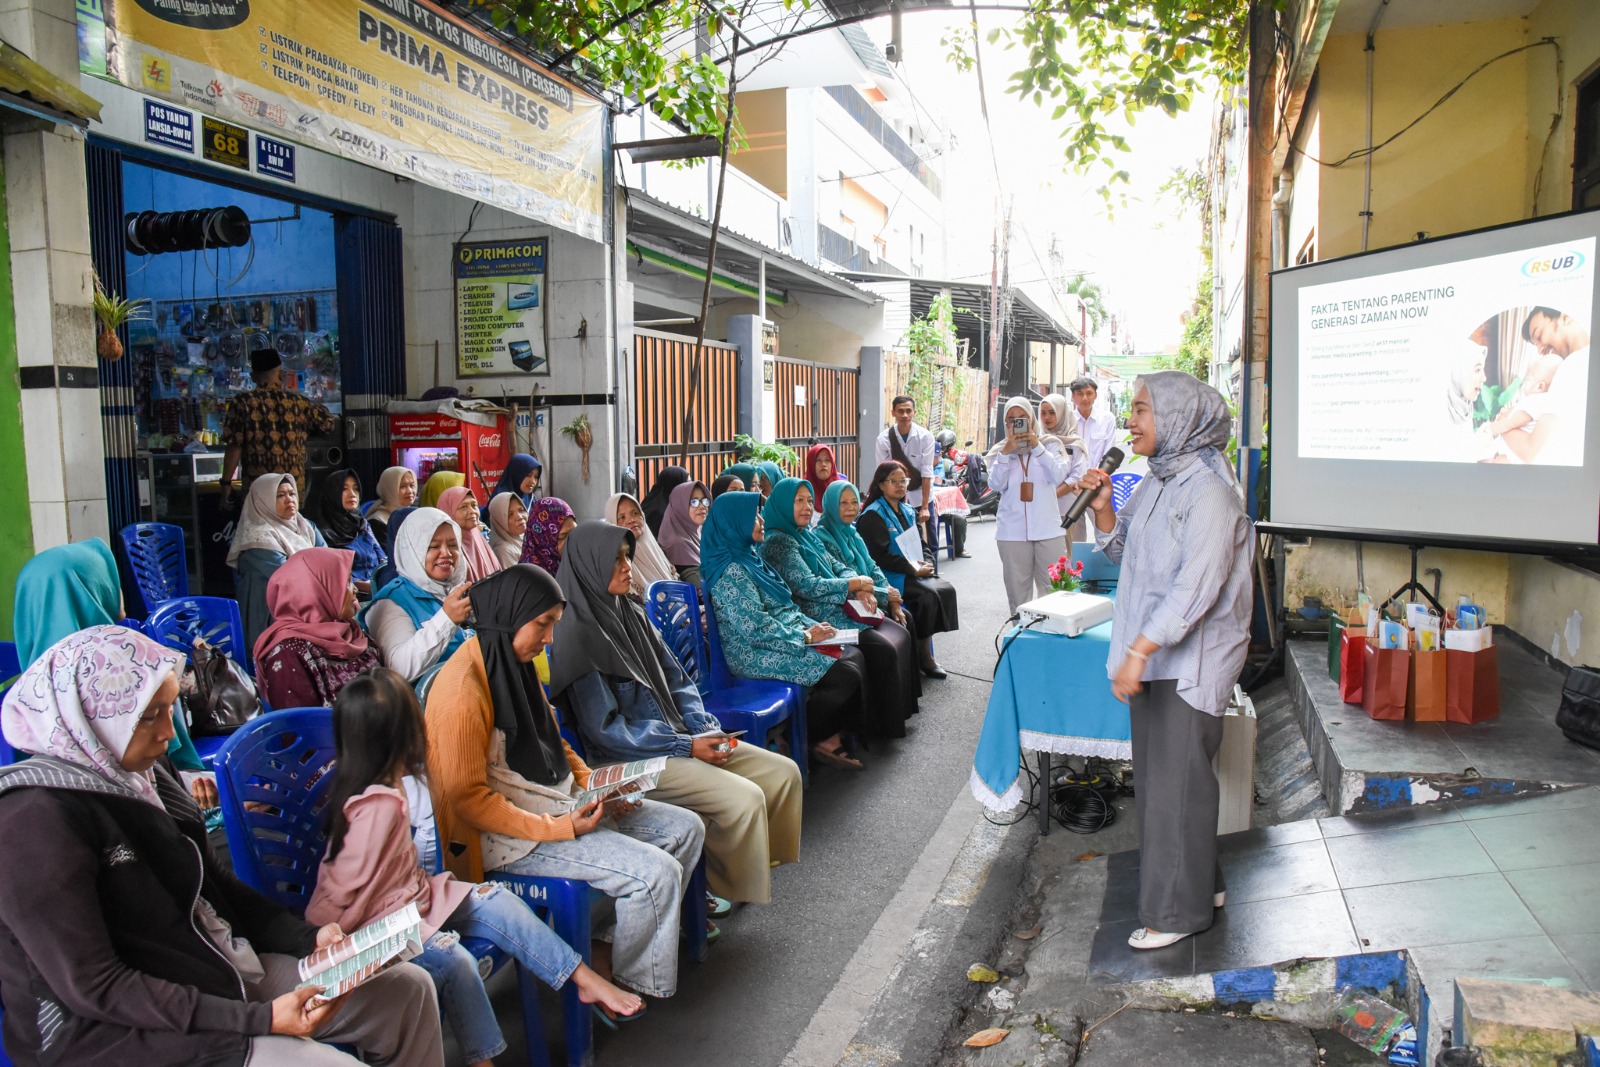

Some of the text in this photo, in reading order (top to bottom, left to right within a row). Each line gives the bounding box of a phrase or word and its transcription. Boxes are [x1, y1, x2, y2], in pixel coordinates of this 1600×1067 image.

[270, 31, 379, 89] LISTRIK PRABAYAR (TOKEN)
[413, 4, 433, 31] PT.
[436, 16, 460, 45] POS
[463, 32, 519, 79] INDONESIA
[522, 66, 570, 108] (PERSERO)
[272, 48, 359, 94] LISTRIK PASCA BAYAR
[358, 9, 450, 83] PRIMA
[456, 60, 549, 131] EXPRESS
[180, 80, 203, 95] Telkom
[272, 64, 310, 90] TELEPON
[317, 84, 347, 105] SPEEDY
[353, 98, 376, 116] FLEXY
[390, 84, 403, 98] HER
[405, 90, 435, 112] TAHUNAN
[150, 105, 189, 127] POS YANDU
[390, 98, 425, 122] ANGSURAN
[427, 114, 453, 134] FINANCE
[390, 113, 404, 127] PBB
[184, 130, 191, 141] IV
[213, 133, 239, 155] 68
[475, 245, 542, 261] PRIMACOM
[1530, 256, 1575, 274] RSUB
[463, 292, 495, 300] CHARGER
[1311, 286, 1455, 316] FAKTA TENTANG PARENTING
[463, 315, 504, 323] PROJECTOR
[1311, 305, 1429, 330] GENERASI ZAMAN NOW
[529, 884, 547, 900] 04
